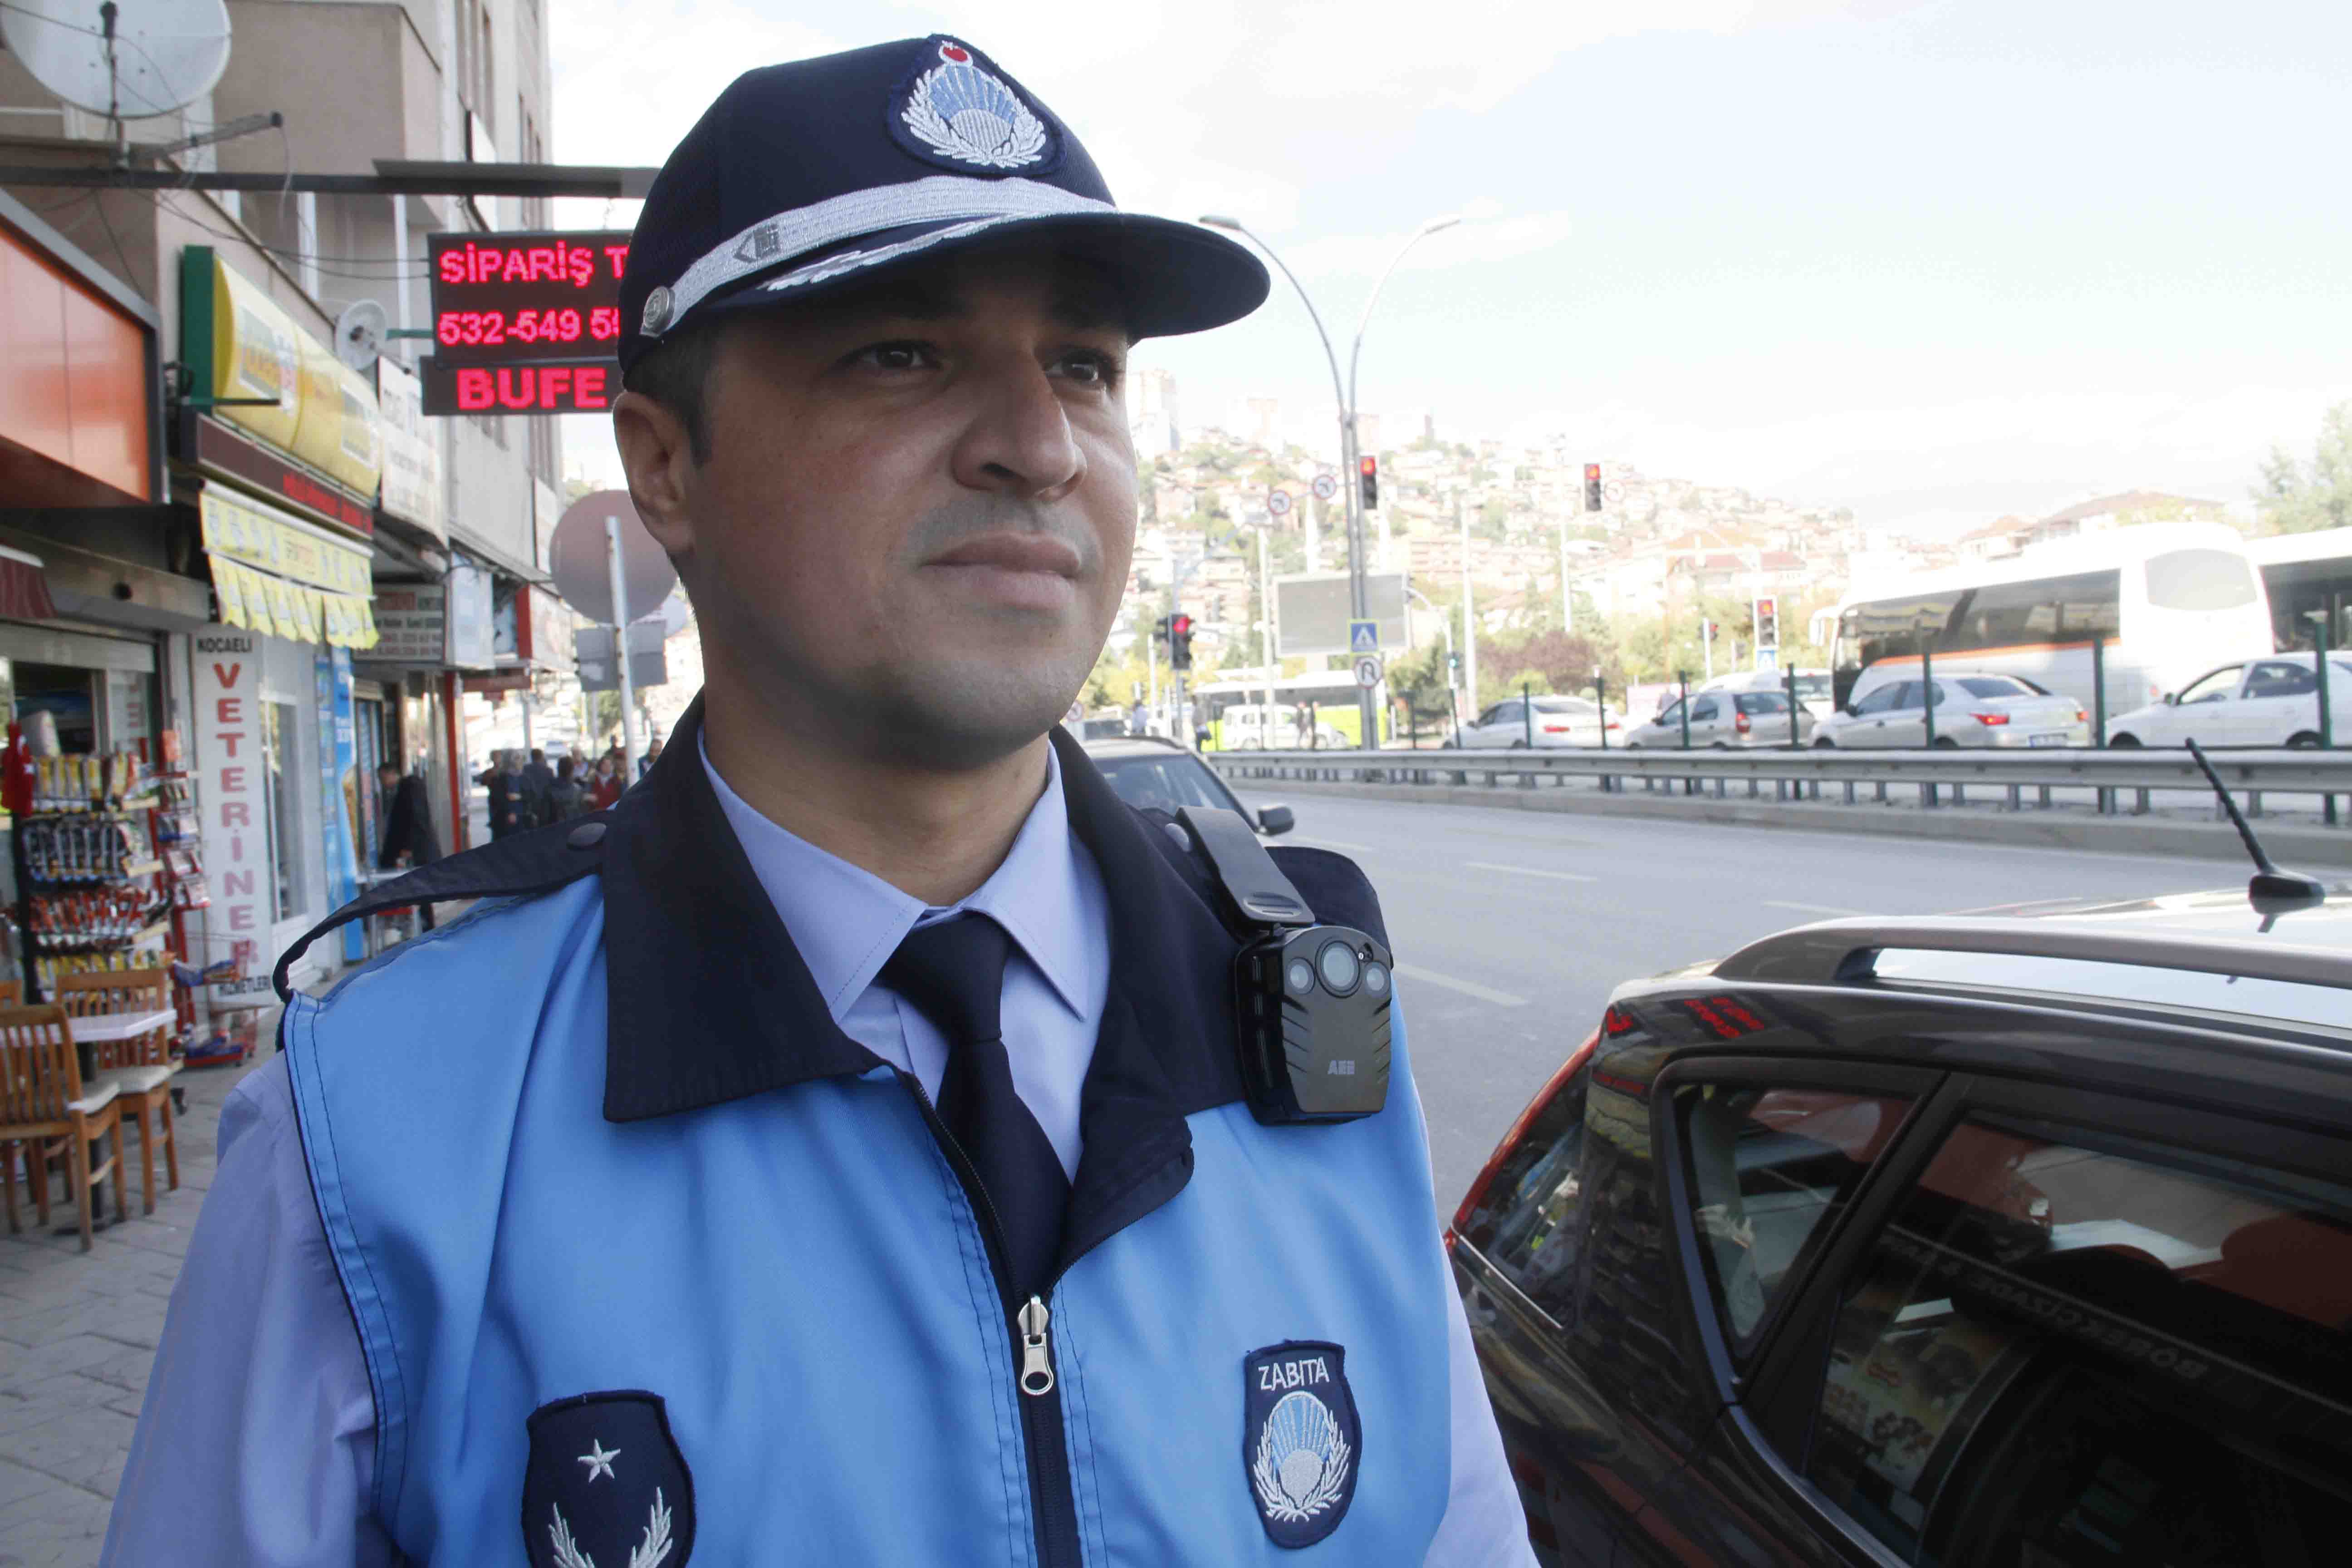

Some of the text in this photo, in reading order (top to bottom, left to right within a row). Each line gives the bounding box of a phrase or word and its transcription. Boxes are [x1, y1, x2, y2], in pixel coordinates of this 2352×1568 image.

[440, 241, 593, 287] SİPARİŞ
[438, 309, 581, 345] 532-549
[457, 368, 608, 410] BUFE
[1258, 1357, 1330, 1392] ZABITA
